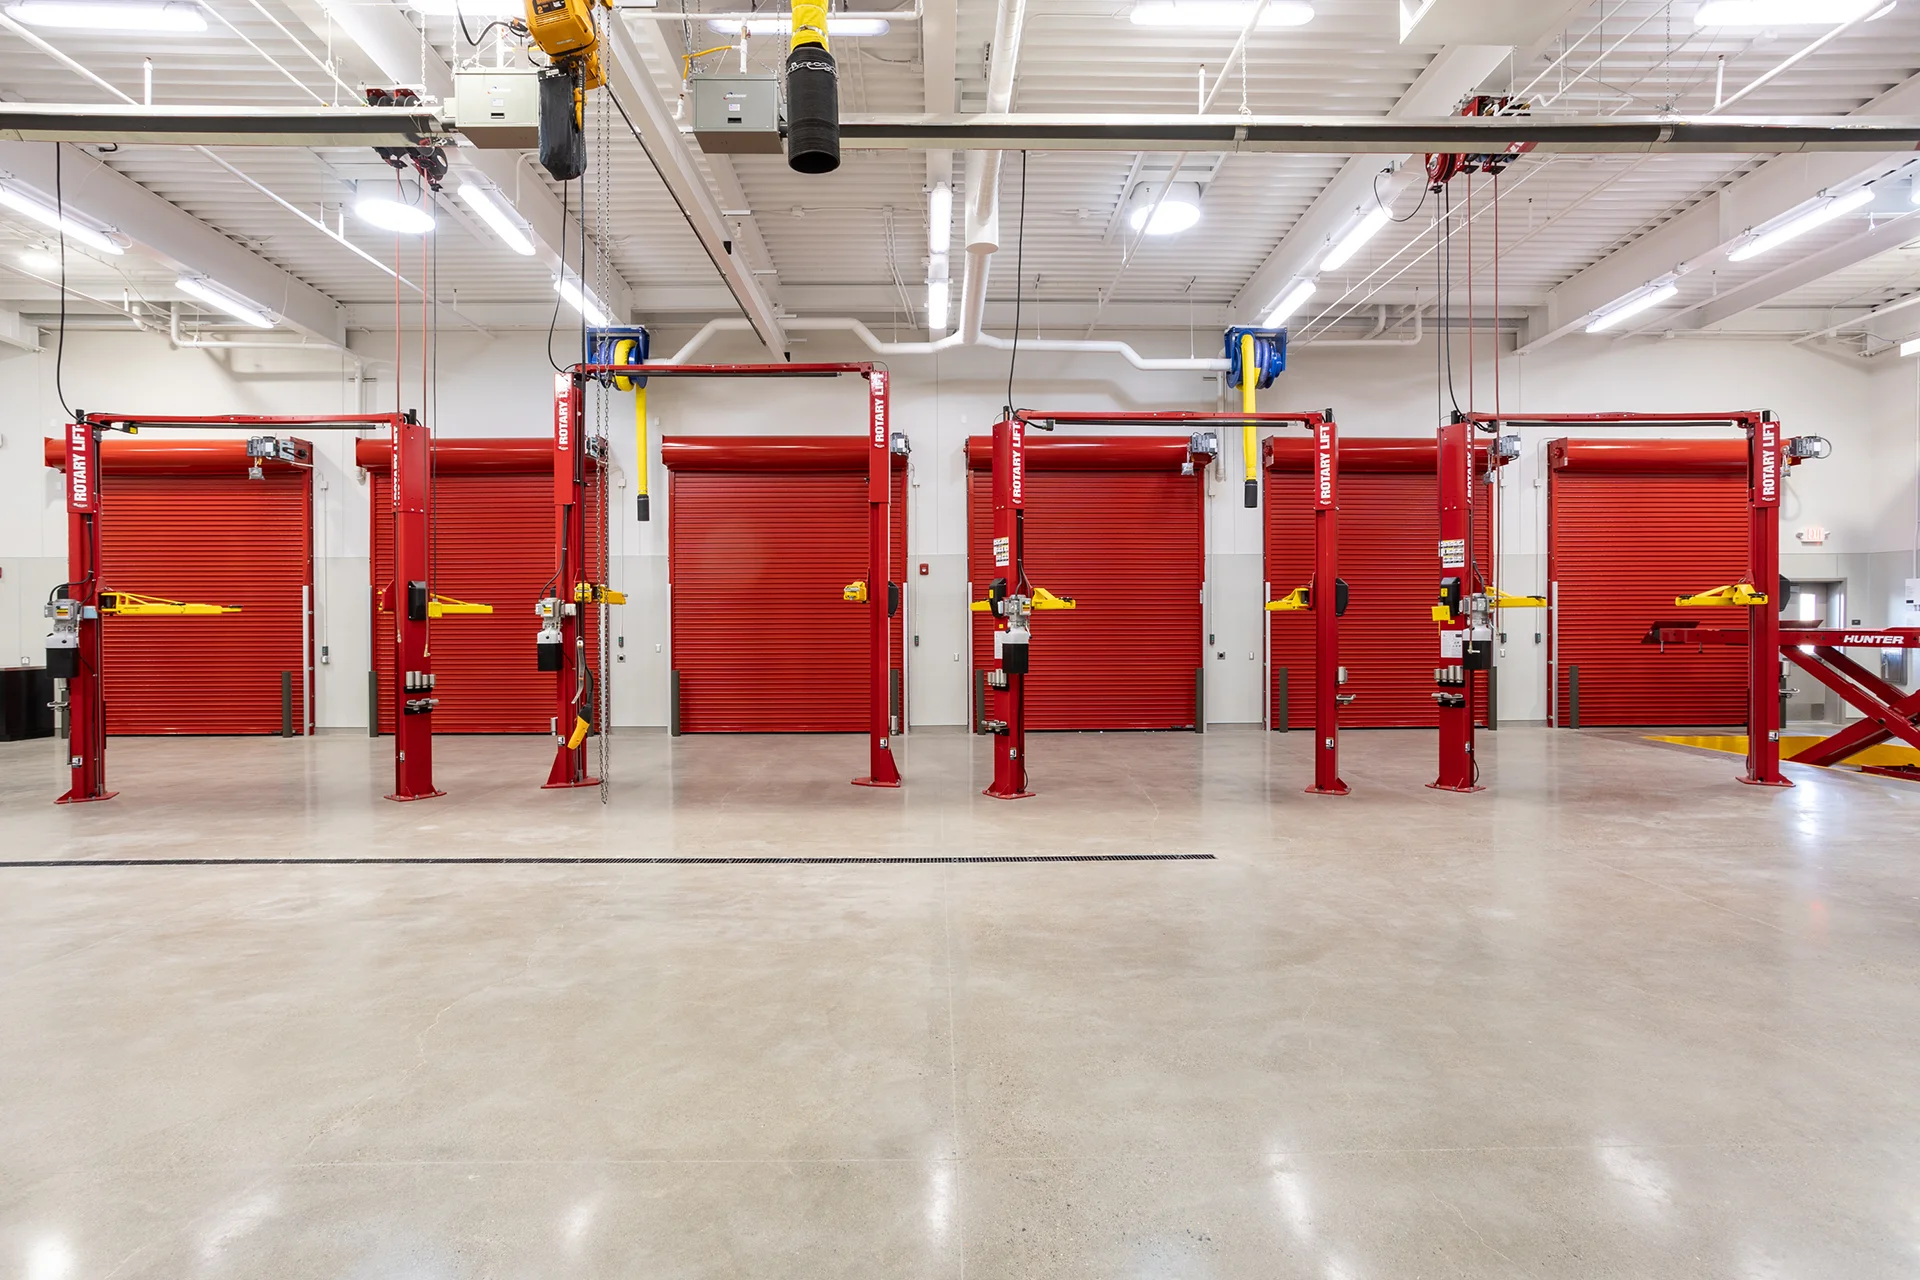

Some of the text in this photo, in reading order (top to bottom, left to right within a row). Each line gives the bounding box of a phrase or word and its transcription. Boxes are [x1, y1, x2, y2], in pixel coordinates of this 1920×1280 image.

[72, 425, 86, 451] LIFT
[559, 401, 568, 445] ROTARY
[875, 399, 884, 442] ROTARY
[1320, 426, 1330, 449] LIFT
[1762, 424, 1774, 447] LIFT
[73, 454, 87, 502] ROTARY
[1013, 421, 1021, 497] ROTARY LIFT
[1320, 453, 1331, 499] ROTARY
[1762, 450, 1775, 495] ROTARY
[1843, 635, 1904, 645] HUNTER
